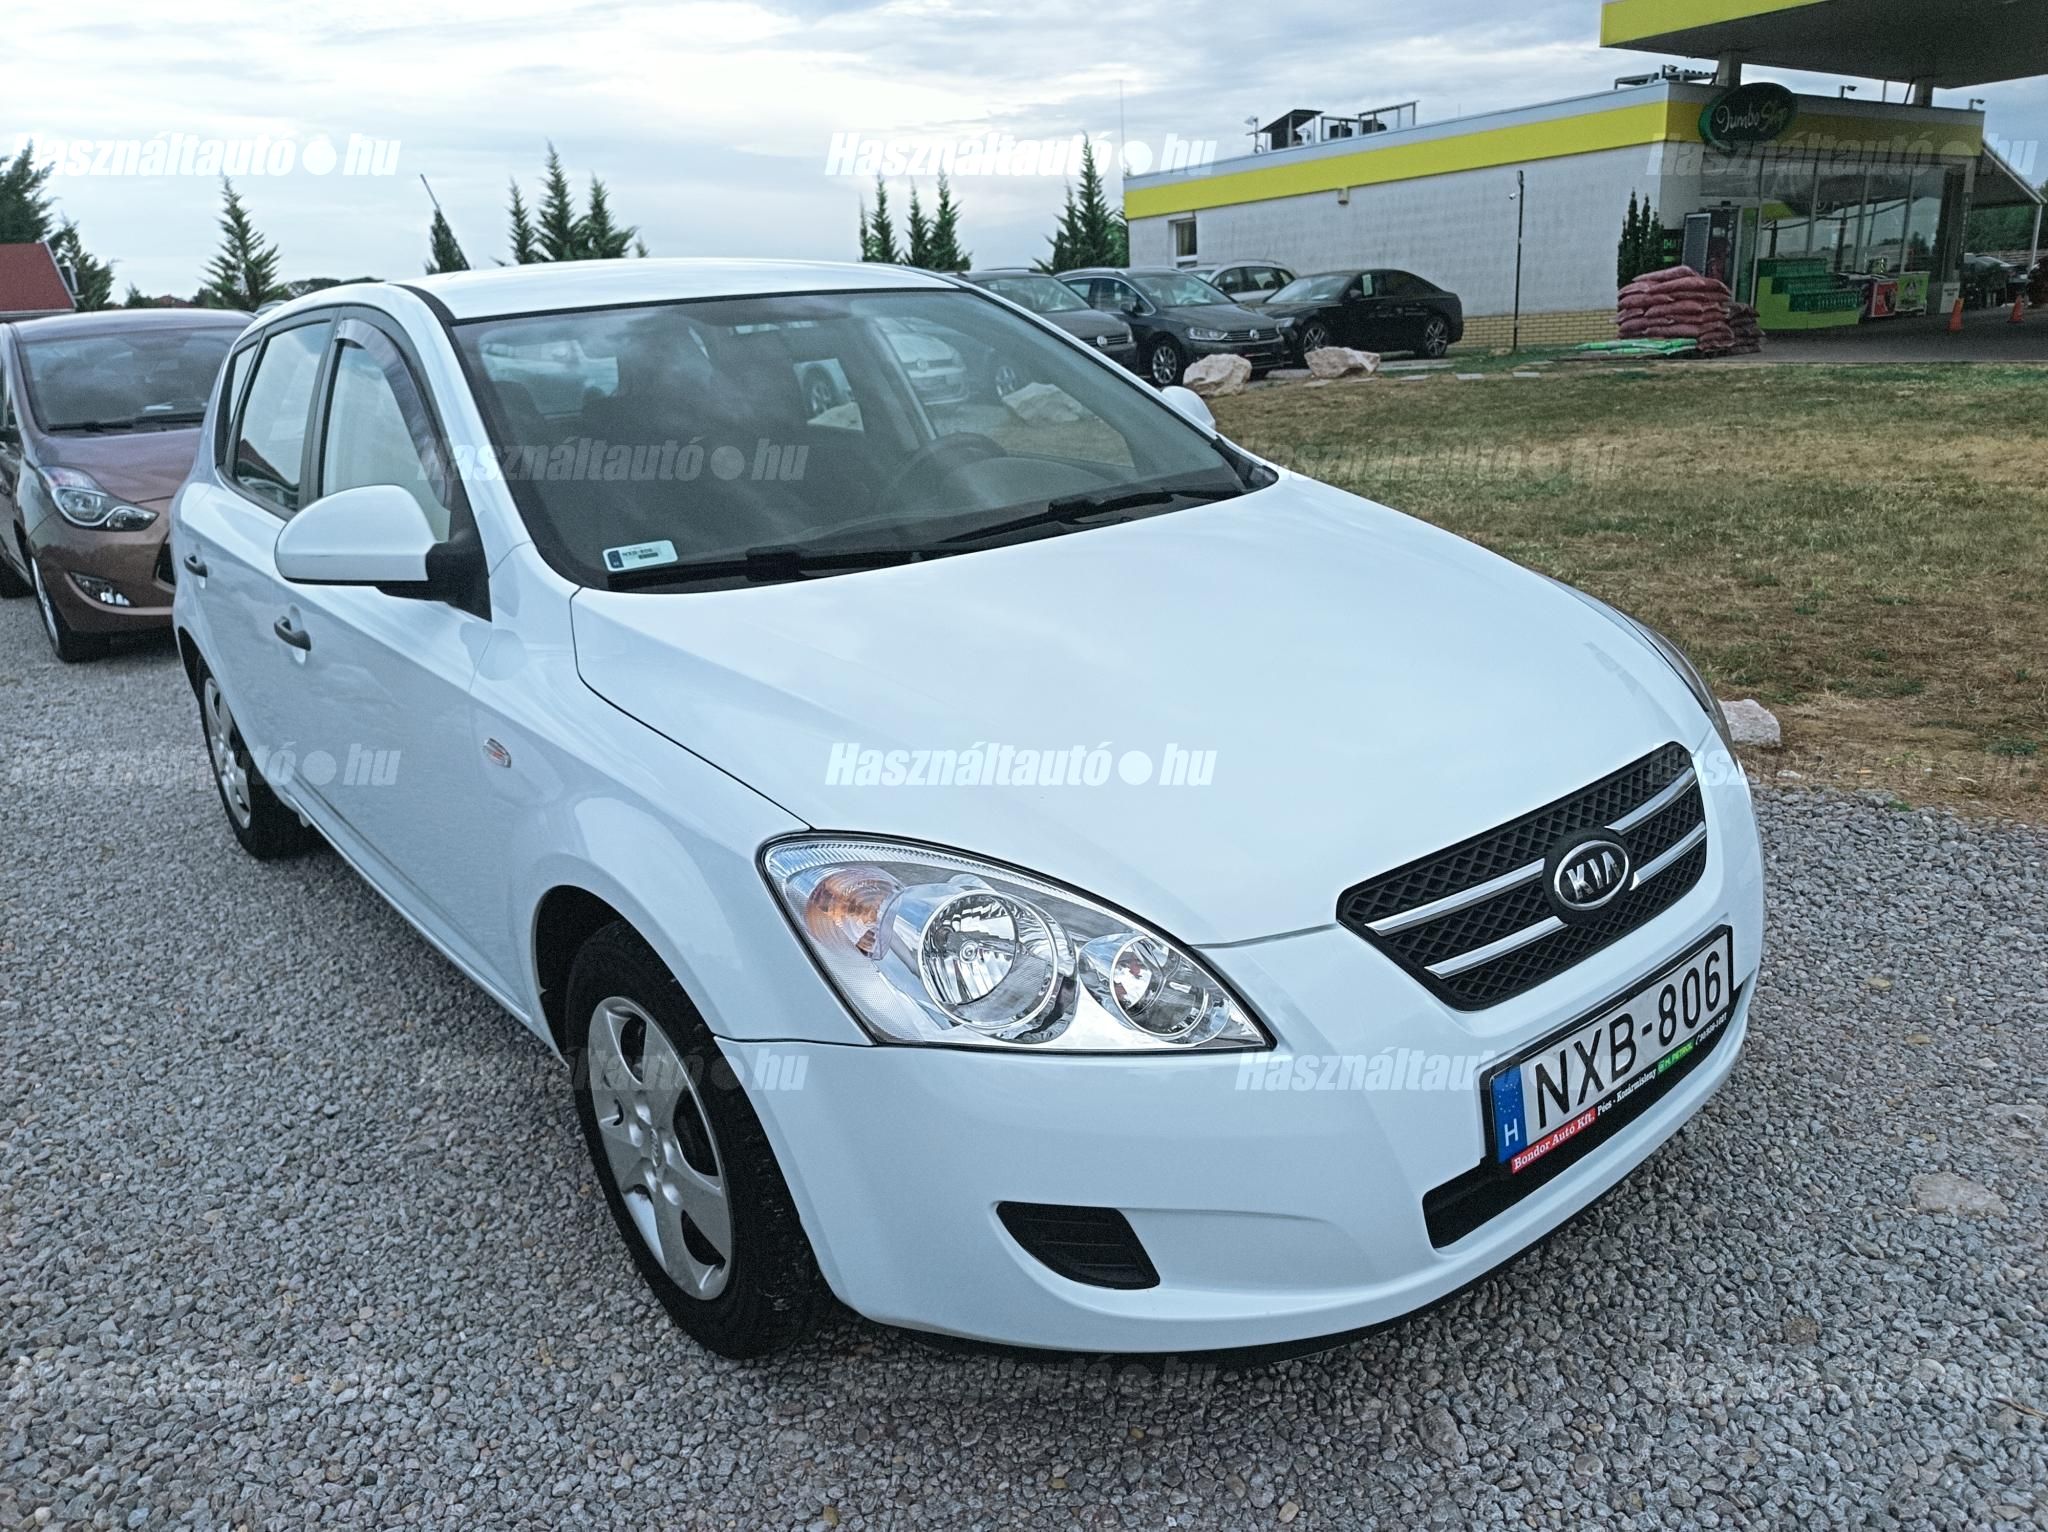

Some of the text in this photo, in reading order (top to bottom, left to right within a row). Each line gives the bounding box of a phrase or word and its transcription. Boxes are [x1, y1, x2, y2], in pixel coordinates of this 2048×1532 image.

[1566, 851, 1621, 900] KIA
[1535, 950, 1721, 1129] NXB-806
[1504, 1118, 1519, 1147] H
[1514, 1139, 1551, 1170] Bondor
[1552, 1122, 1575, 1146] Autó
[1577, 1111, 1595, 1131] Kft.
